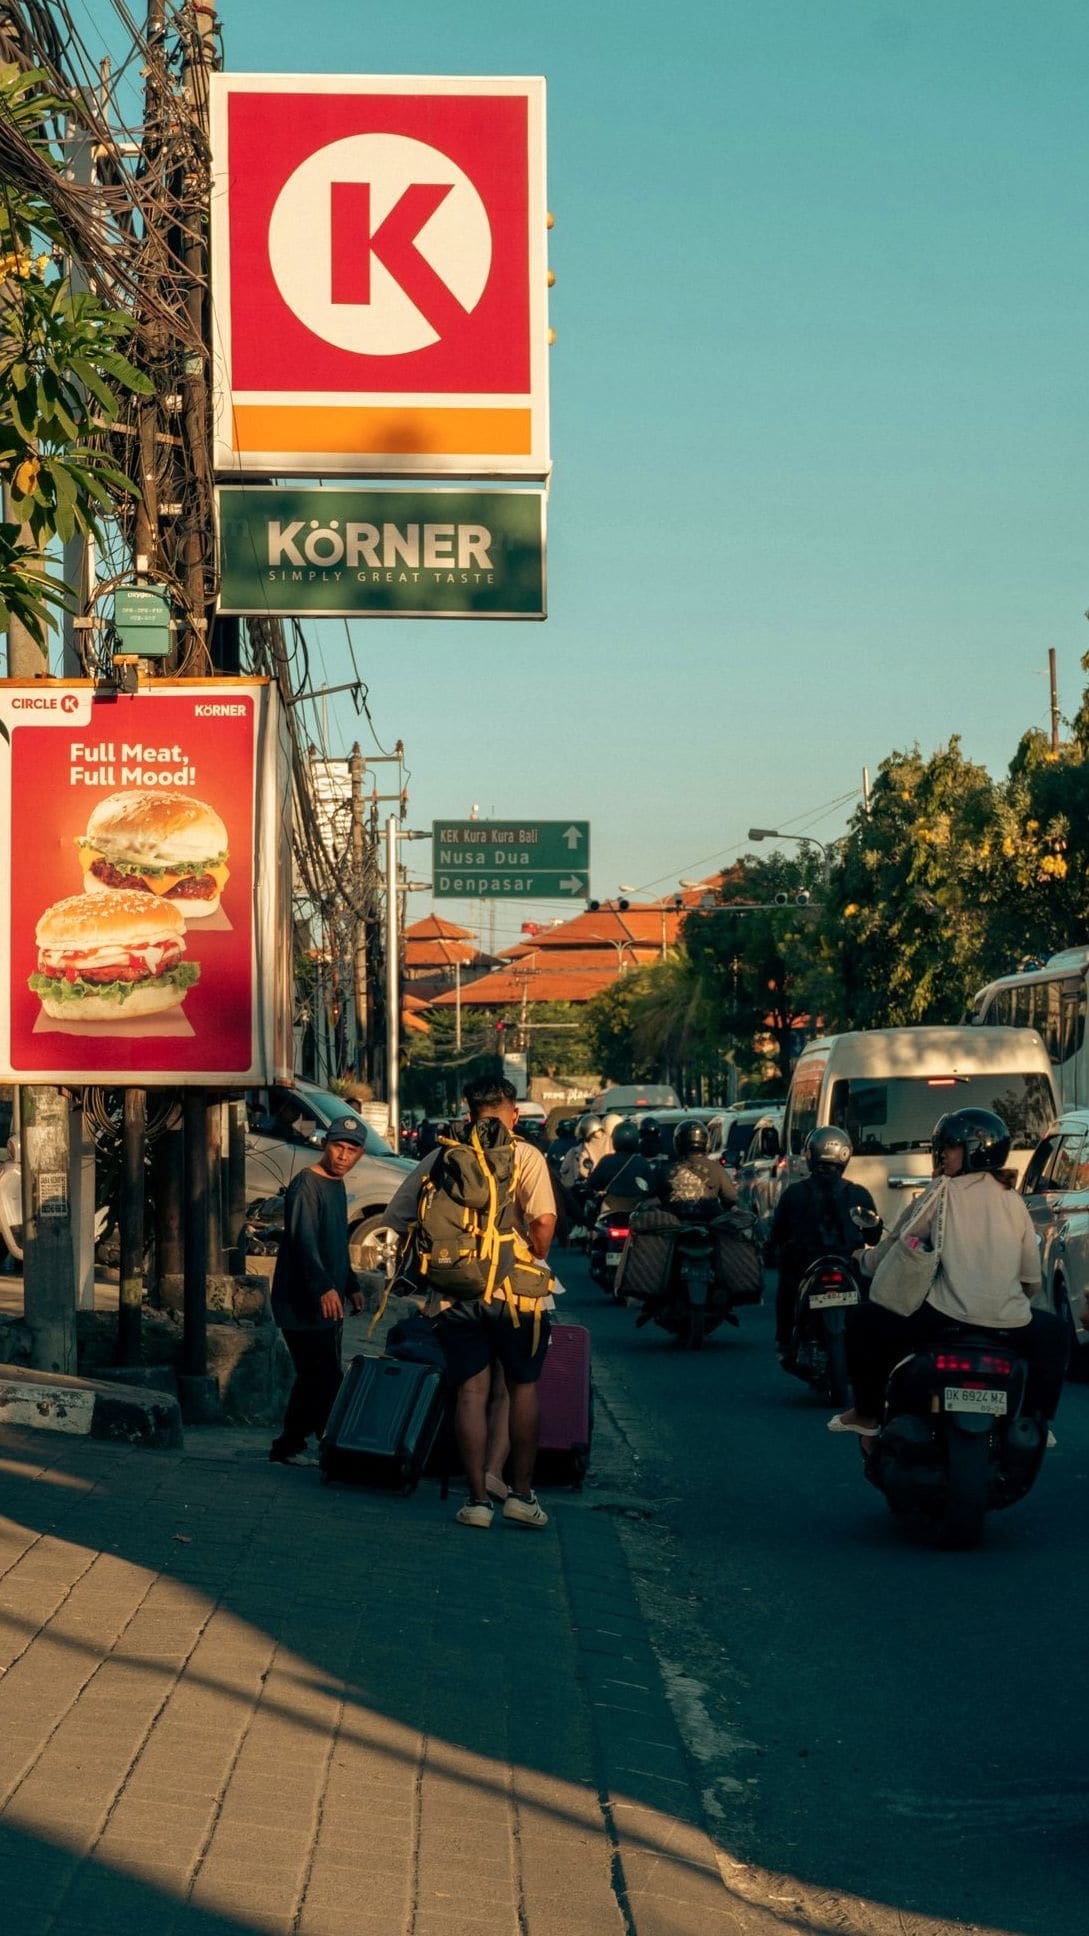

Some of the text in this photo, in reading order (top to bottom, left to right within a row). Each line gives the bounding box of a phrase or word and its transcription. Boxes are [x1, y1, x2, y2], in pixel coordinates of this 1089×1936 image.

[268, 519, 494, 570] KÖRNER
[268, 570, 495, 584] SIMPLY GREAT TASTE
[11, 696, 77, 713] CIRCLE K
[194, 704, 247, 718] KÖRNER
[69, 743, 189, 765] Full Meat,
[69, 766, 196, 786] Full Mood!
[440, 829, 538, 843] KEK Kura Kura Bali
[440, 851, 529, 864] Nusa Dua
[440, 877, 534, 894] Denpasar
[946, 1389, 960, 1401] DK
[962, 1390, 988, 1402] 6924
